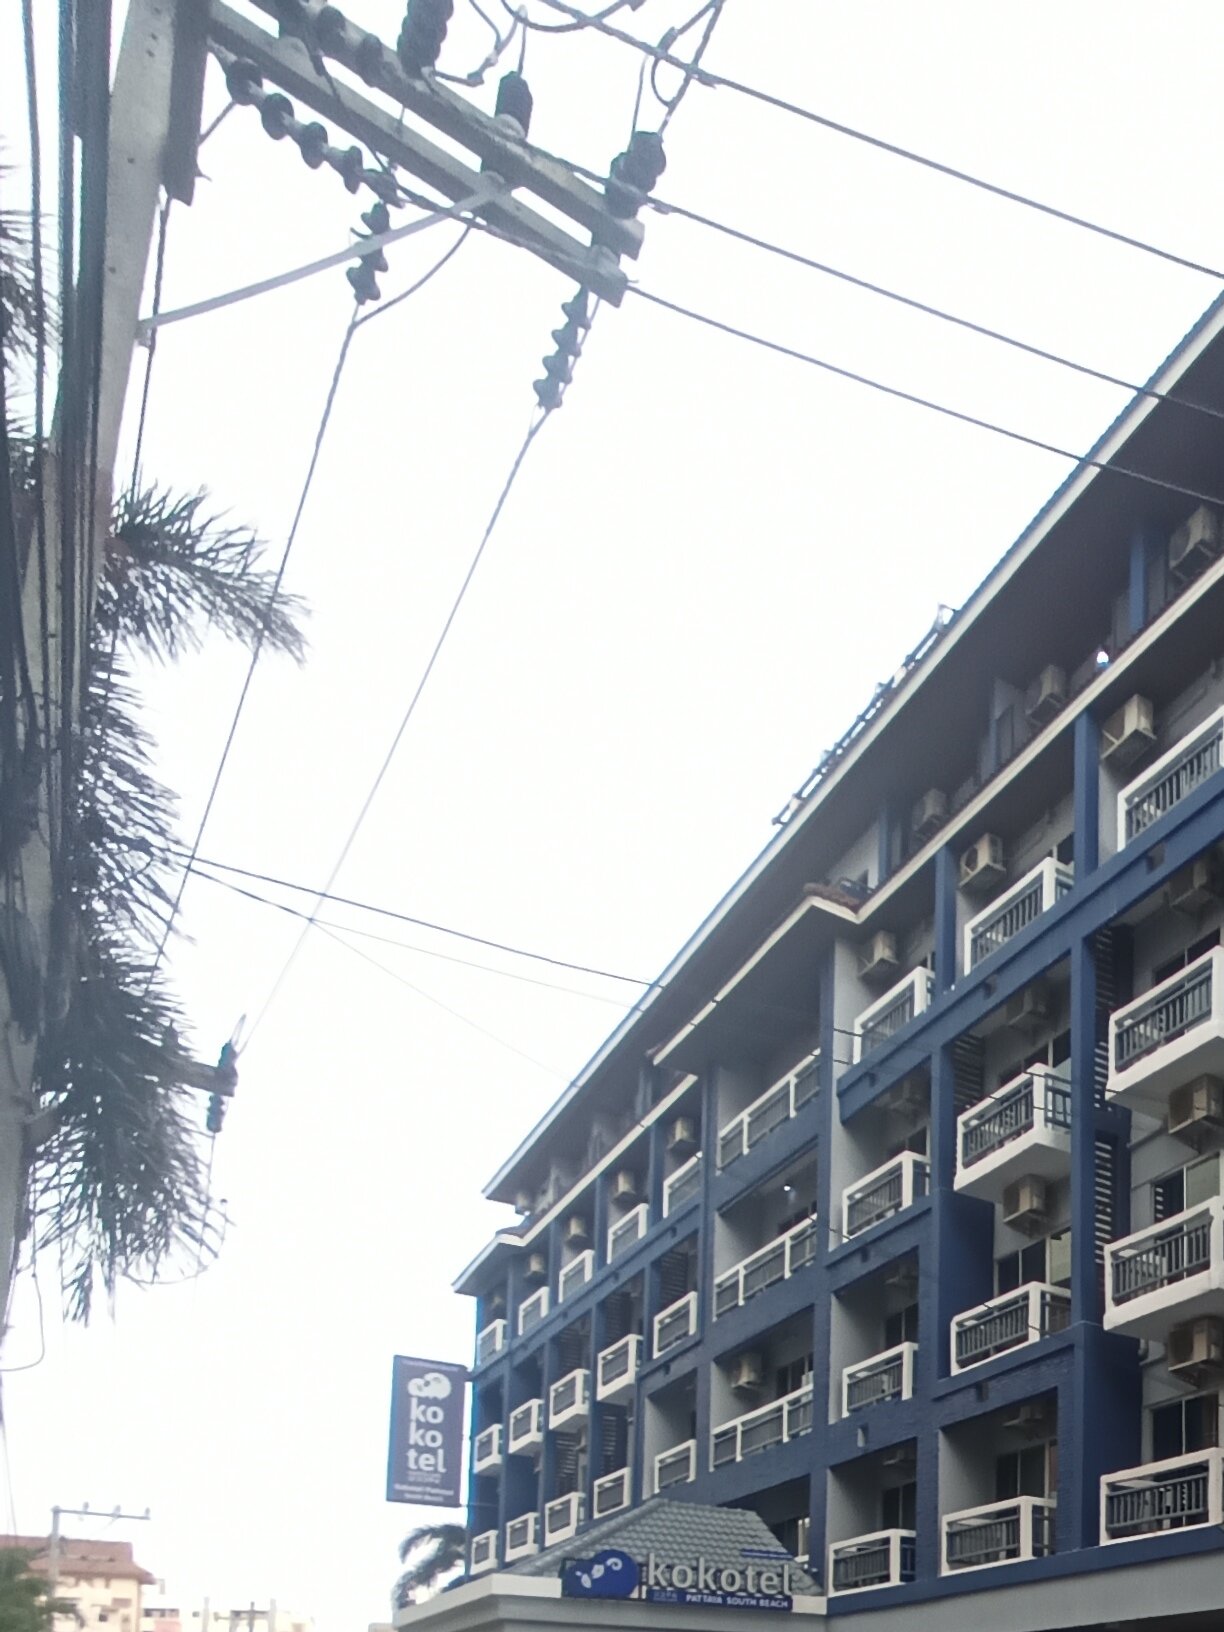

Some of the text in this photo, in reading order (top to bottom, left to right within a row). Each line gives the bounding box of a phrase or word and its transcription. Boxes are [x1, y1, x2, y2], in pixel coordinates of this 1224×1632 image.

[410, 1397, 444, 1424] ko
[408, 1421, 443, 1447] ko
[407, 1448, 446, 1473] tel
[648, 1552, 793, 1595] kokotel
[726, 1596, 757, 1606] SOUTH
[759, 1599, 788, 1608] BEACH
